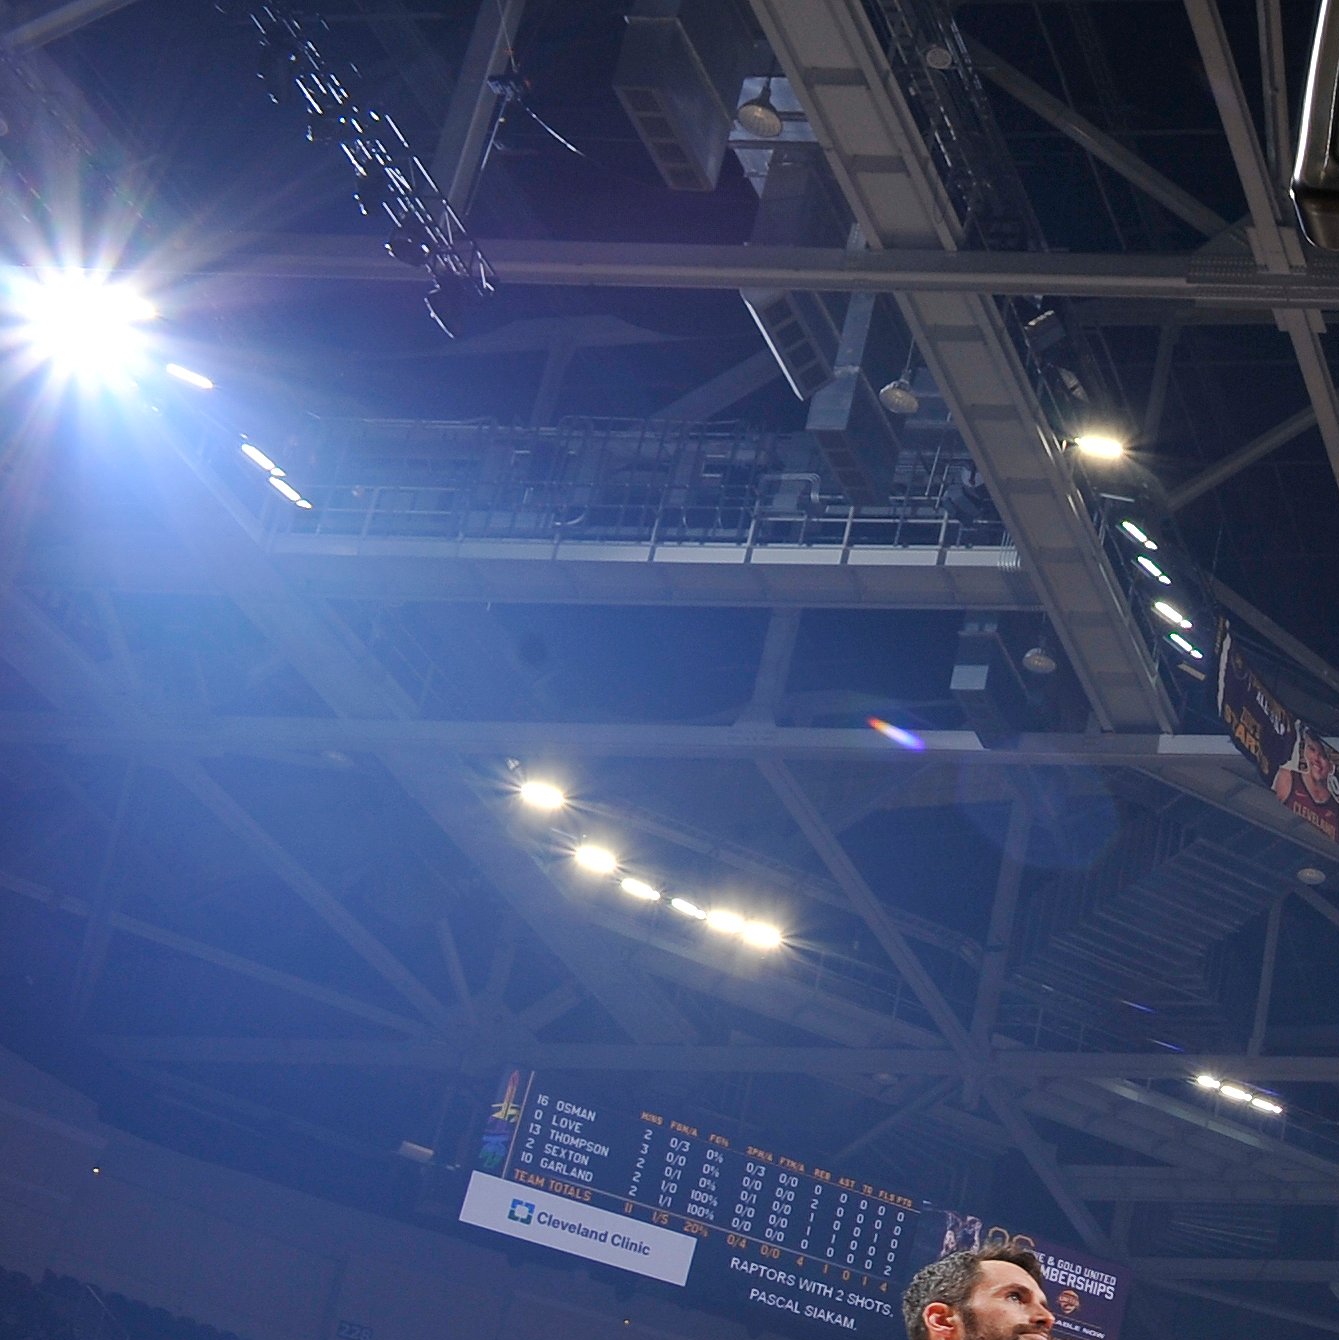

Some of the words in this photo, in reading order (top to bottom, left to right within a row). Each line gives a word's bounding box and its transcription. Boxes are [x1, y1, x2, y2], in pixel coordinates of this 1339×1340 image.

[551, 1114, 582, 1133] LOVE
[556, 1100, 597, 1122] OSMAN
[544, 1143, 590, 1165] SEXTON
[550, 1128, 610, 1157] THOMPSON
[540, 1158, 593, 1182] GARLAND
[514, 1168, 545, 1188] TEAM
[550, 1177, 592, 1202] TOTALS
[537, 1211, 609, 1244] Cleveland
[610, 1233, 650, 1256] Clinic
[730, 1257, 796, 1287] RAPTORS
[799, 1277, 834, 1299] WITH
[835, 1289, 845, 1302] 2
[847, 1293, 894, 1318] SHOTS.
[1040, 1266, 1116, 1300] MBERSHIPS
[1057, 1259, 1082, 1275] GOLD
[1084, 1267, 1117, 1287] UNITED
[749, 1288, 801, 1314] PASCAL
[804, 1305, 857, 1331] SIAKAM.
